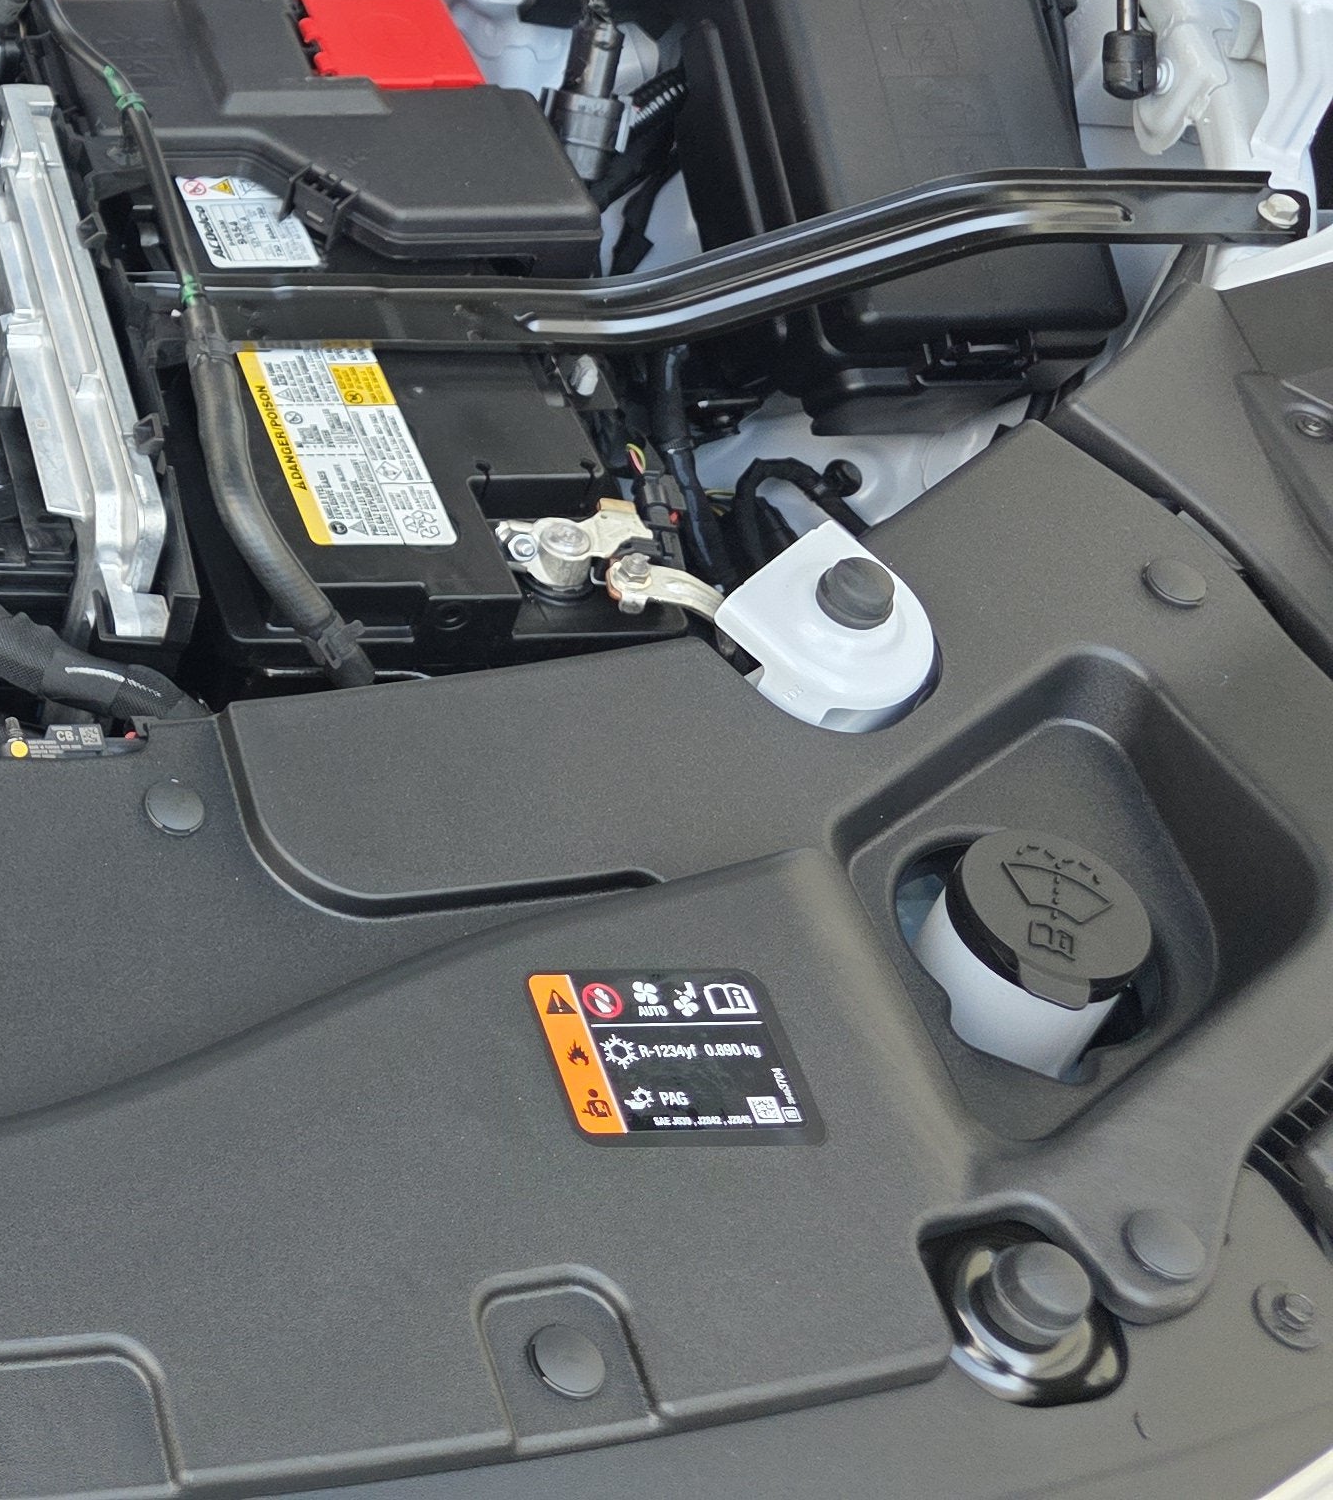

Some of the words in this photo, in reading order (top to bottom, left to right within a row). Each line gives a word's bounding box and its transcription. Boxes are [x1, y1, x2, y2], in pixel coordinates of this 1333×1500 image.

[195, 205, 227, 260] ACDelco
[256, 385, 302, 481] DANGER/POISON
[638, 1005, 668, 1017] AUTO
[638, 1044, 697, 1060] R-1234yf
[742, 1043, 762, 1058] kg
[659, 1091, 689, 1106] PAG
